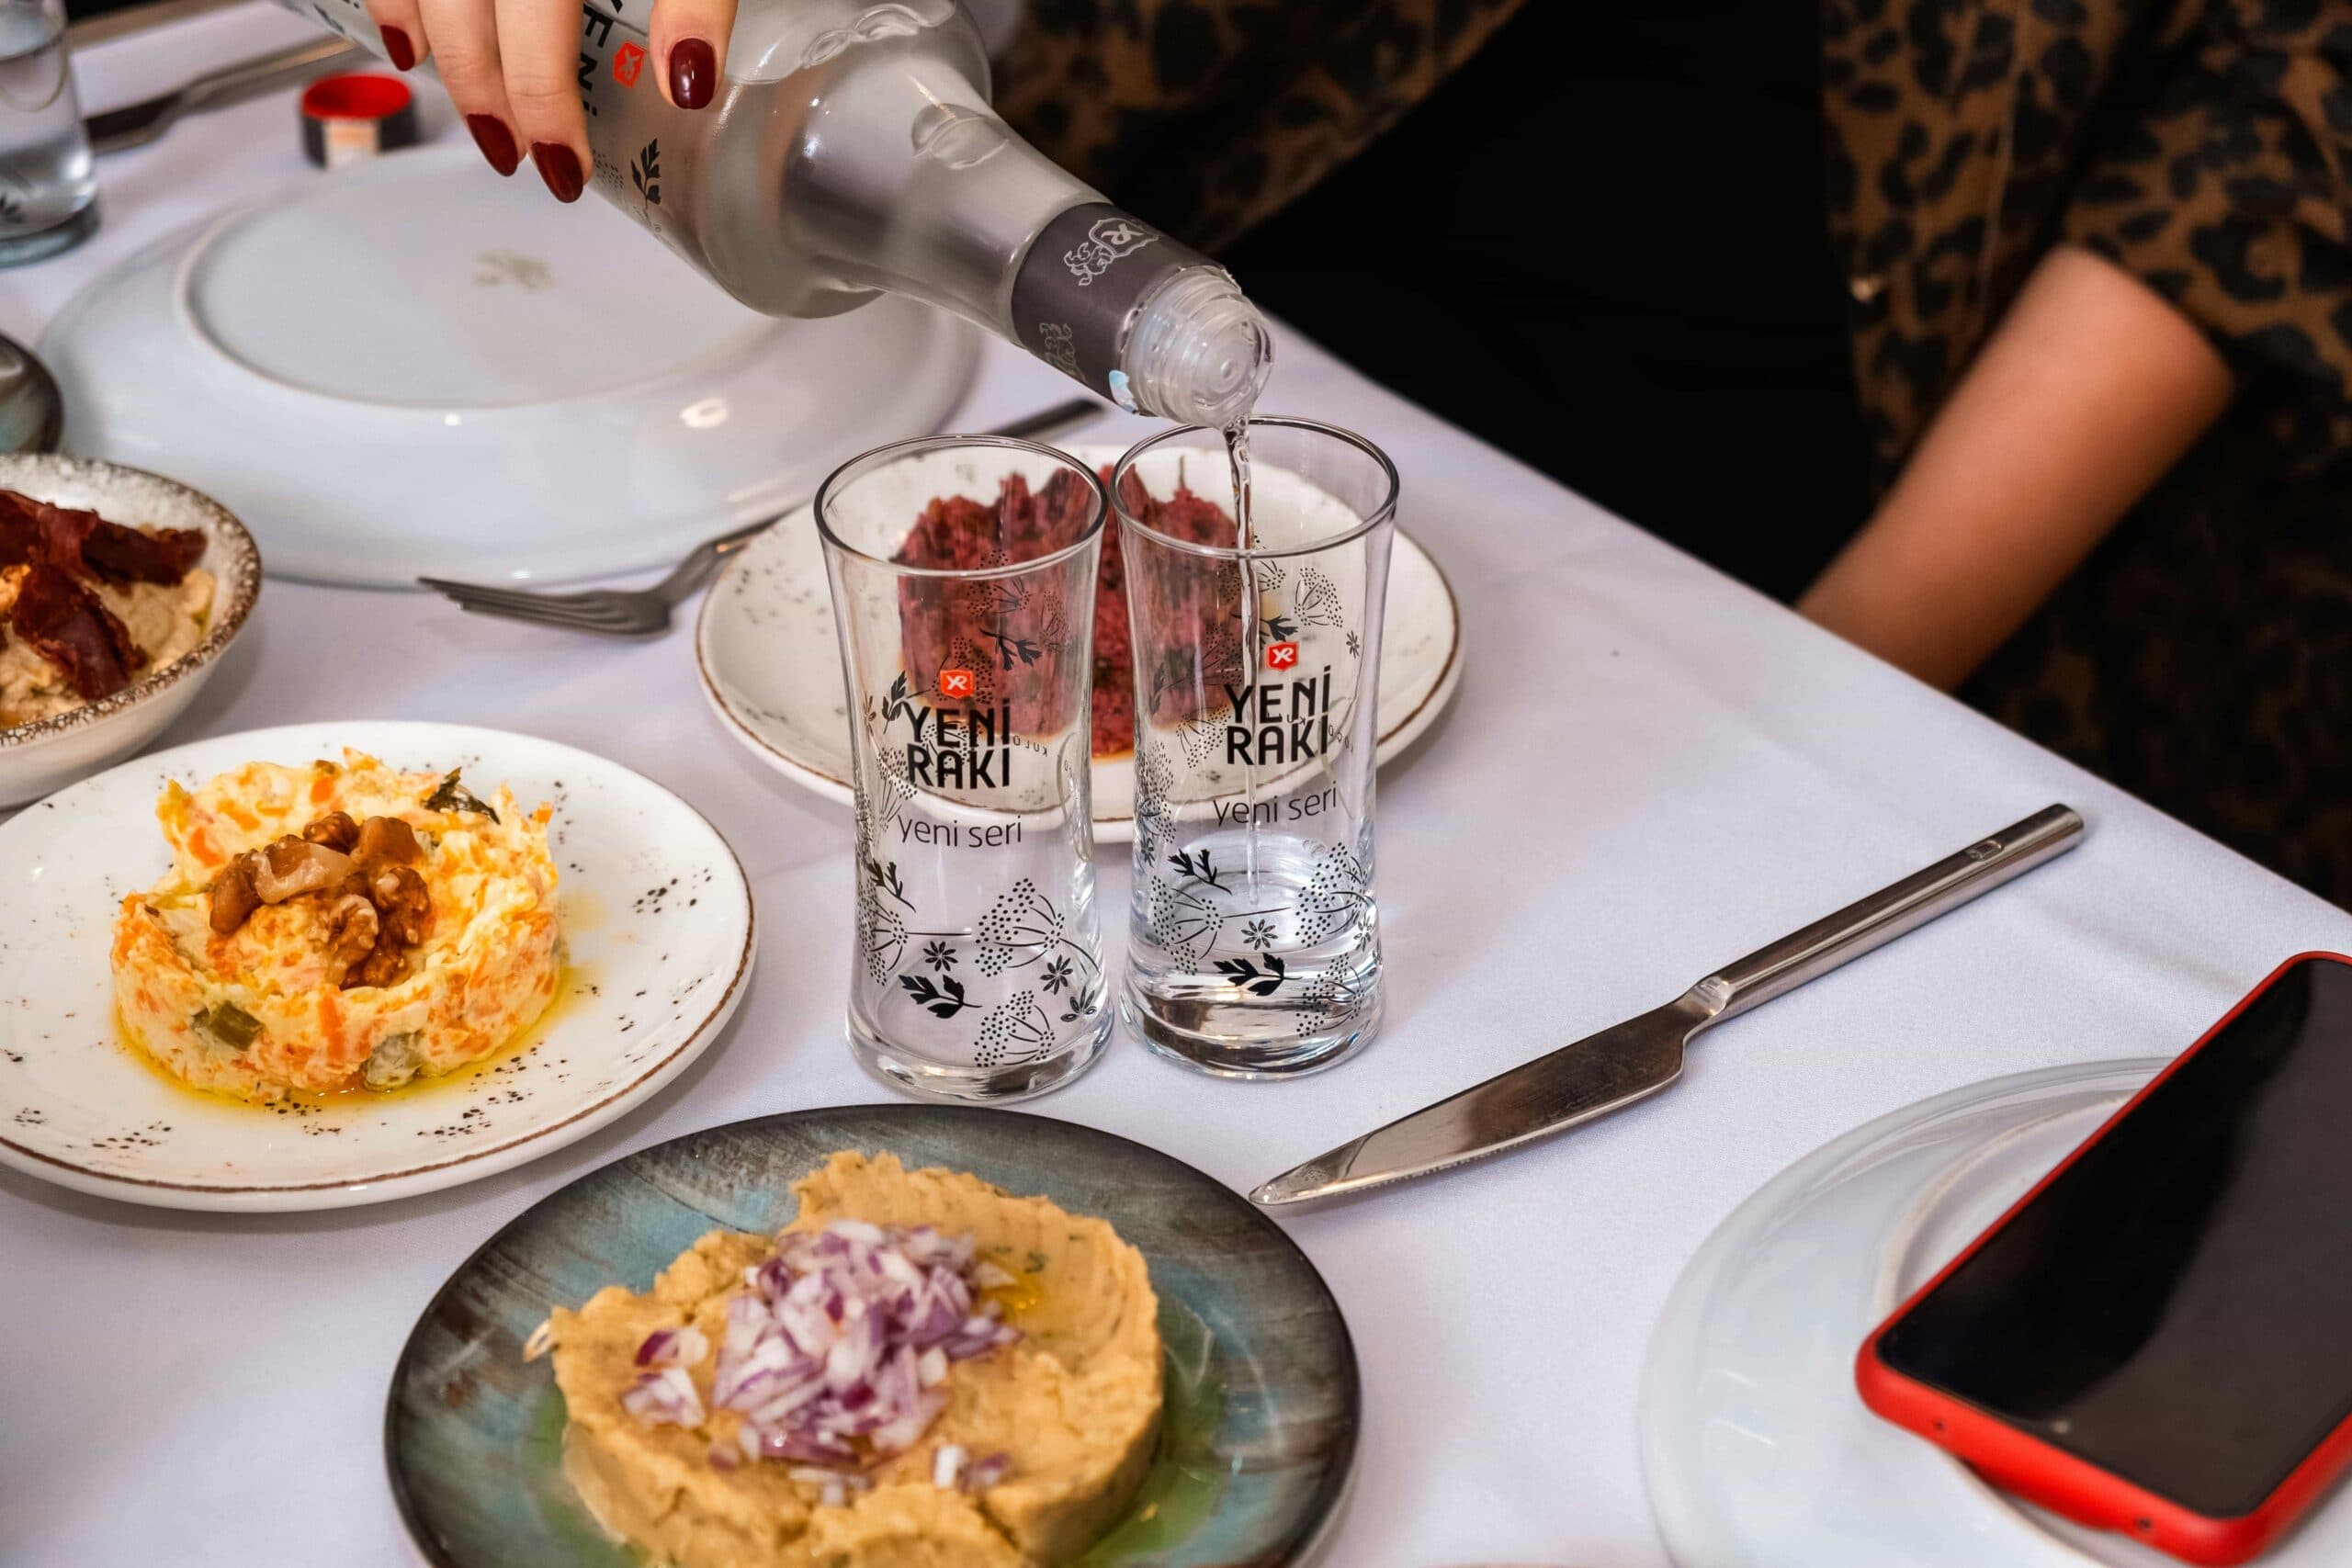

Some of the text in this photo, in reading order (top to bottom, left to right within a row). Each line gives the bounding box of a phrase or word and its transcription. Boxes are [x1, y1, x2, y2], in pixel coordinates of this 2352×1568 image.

[1224, 665, 1330, 724] YENİ
[900, 698, 1010, 748] YENİ
[1227, 715, 1328, 765] RAKI
[907, 743, 1010, 790] RAKI
[1213, 781, 1337, 827] yeni seri
[897, 814, 1022, 848] yeni seri
